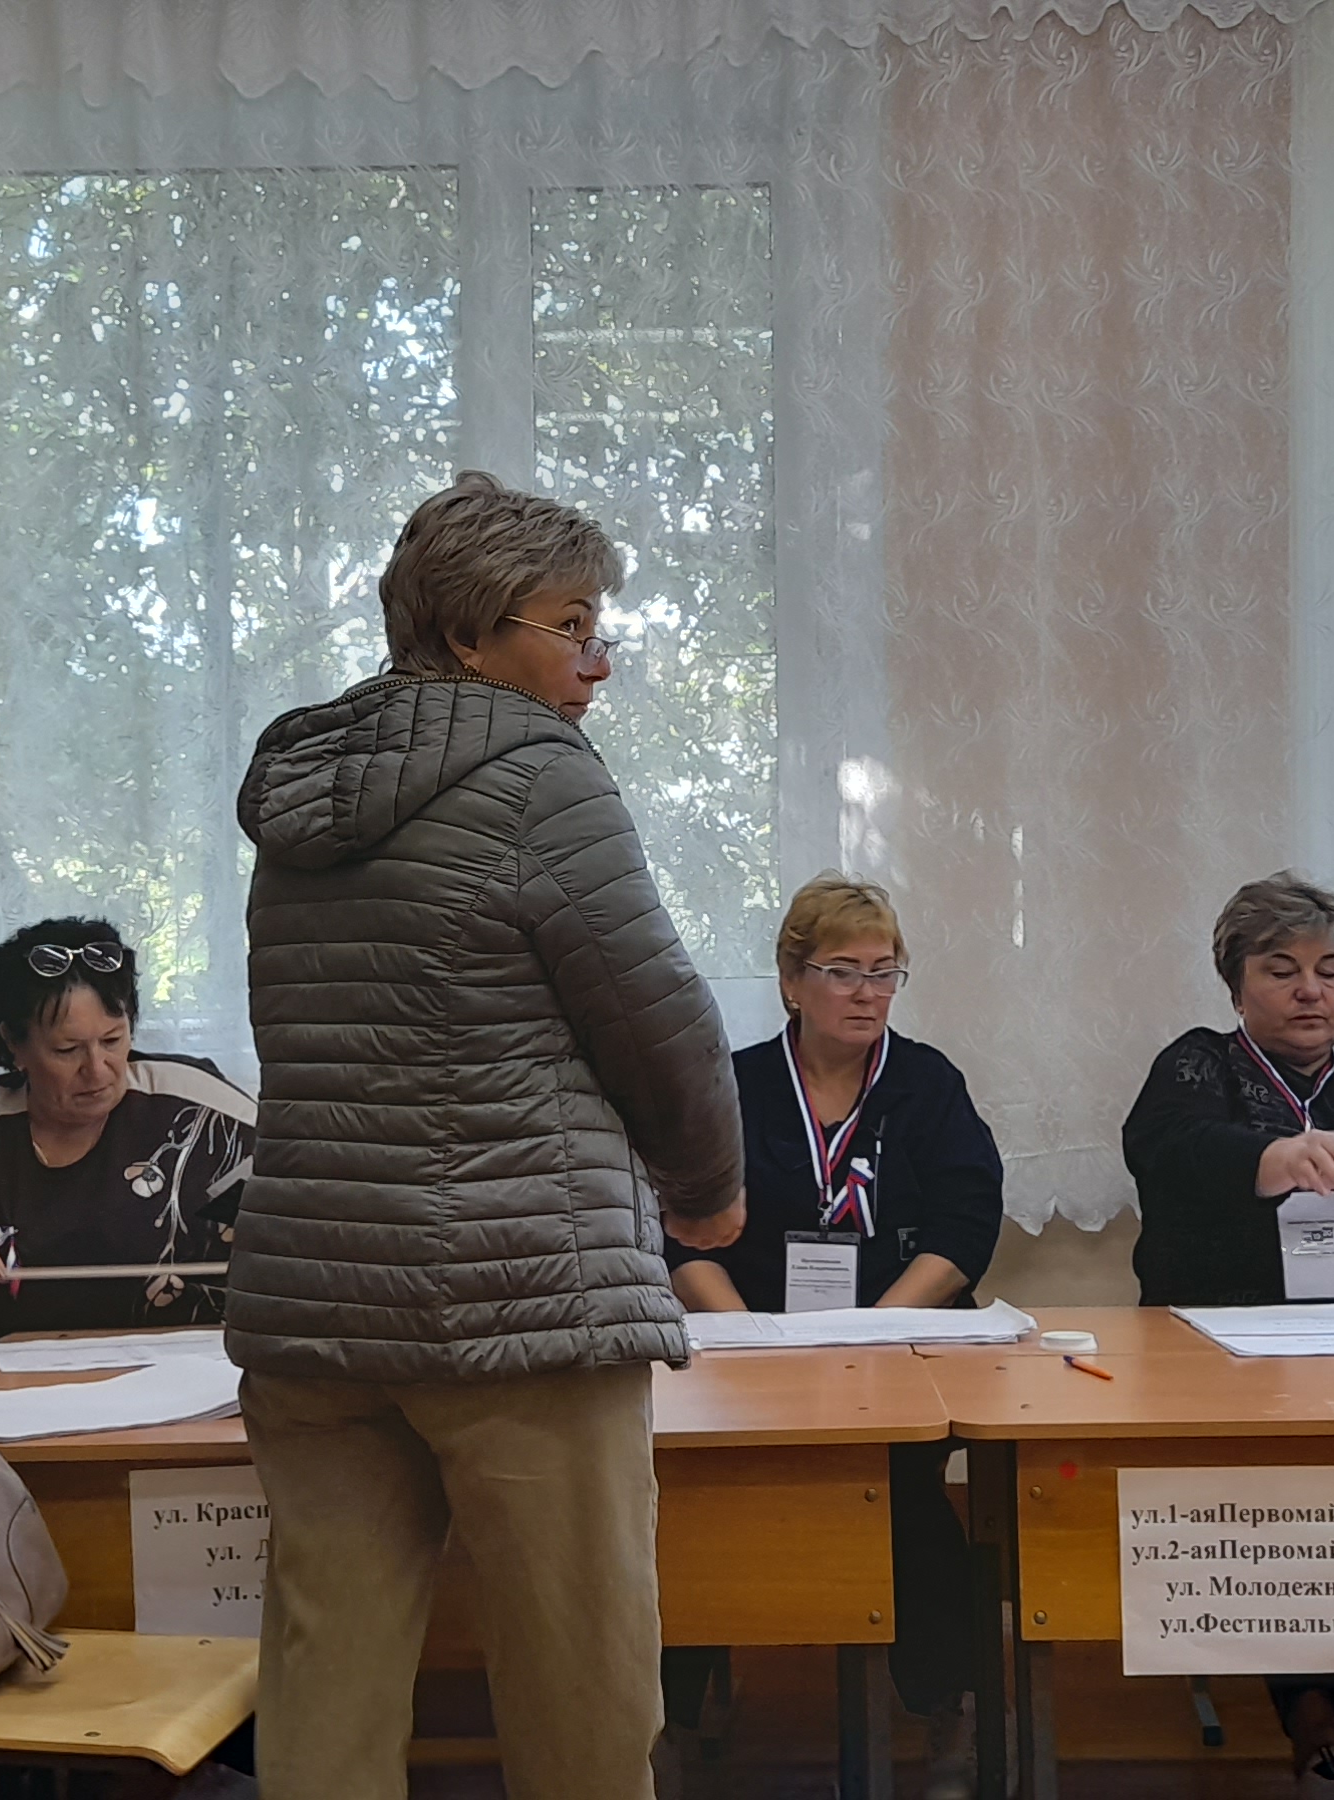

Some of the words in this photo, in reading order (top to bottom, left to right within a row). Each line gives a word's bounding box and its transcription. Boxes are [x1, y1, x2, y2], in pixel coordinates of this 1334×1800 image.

[153, 1509, 188, 1530] ул.
[206, 1546, 241, 1568] ул.
[212, 1585, 248, 1607] ул.
[1165, 1581, 1202, 1603] ул.
